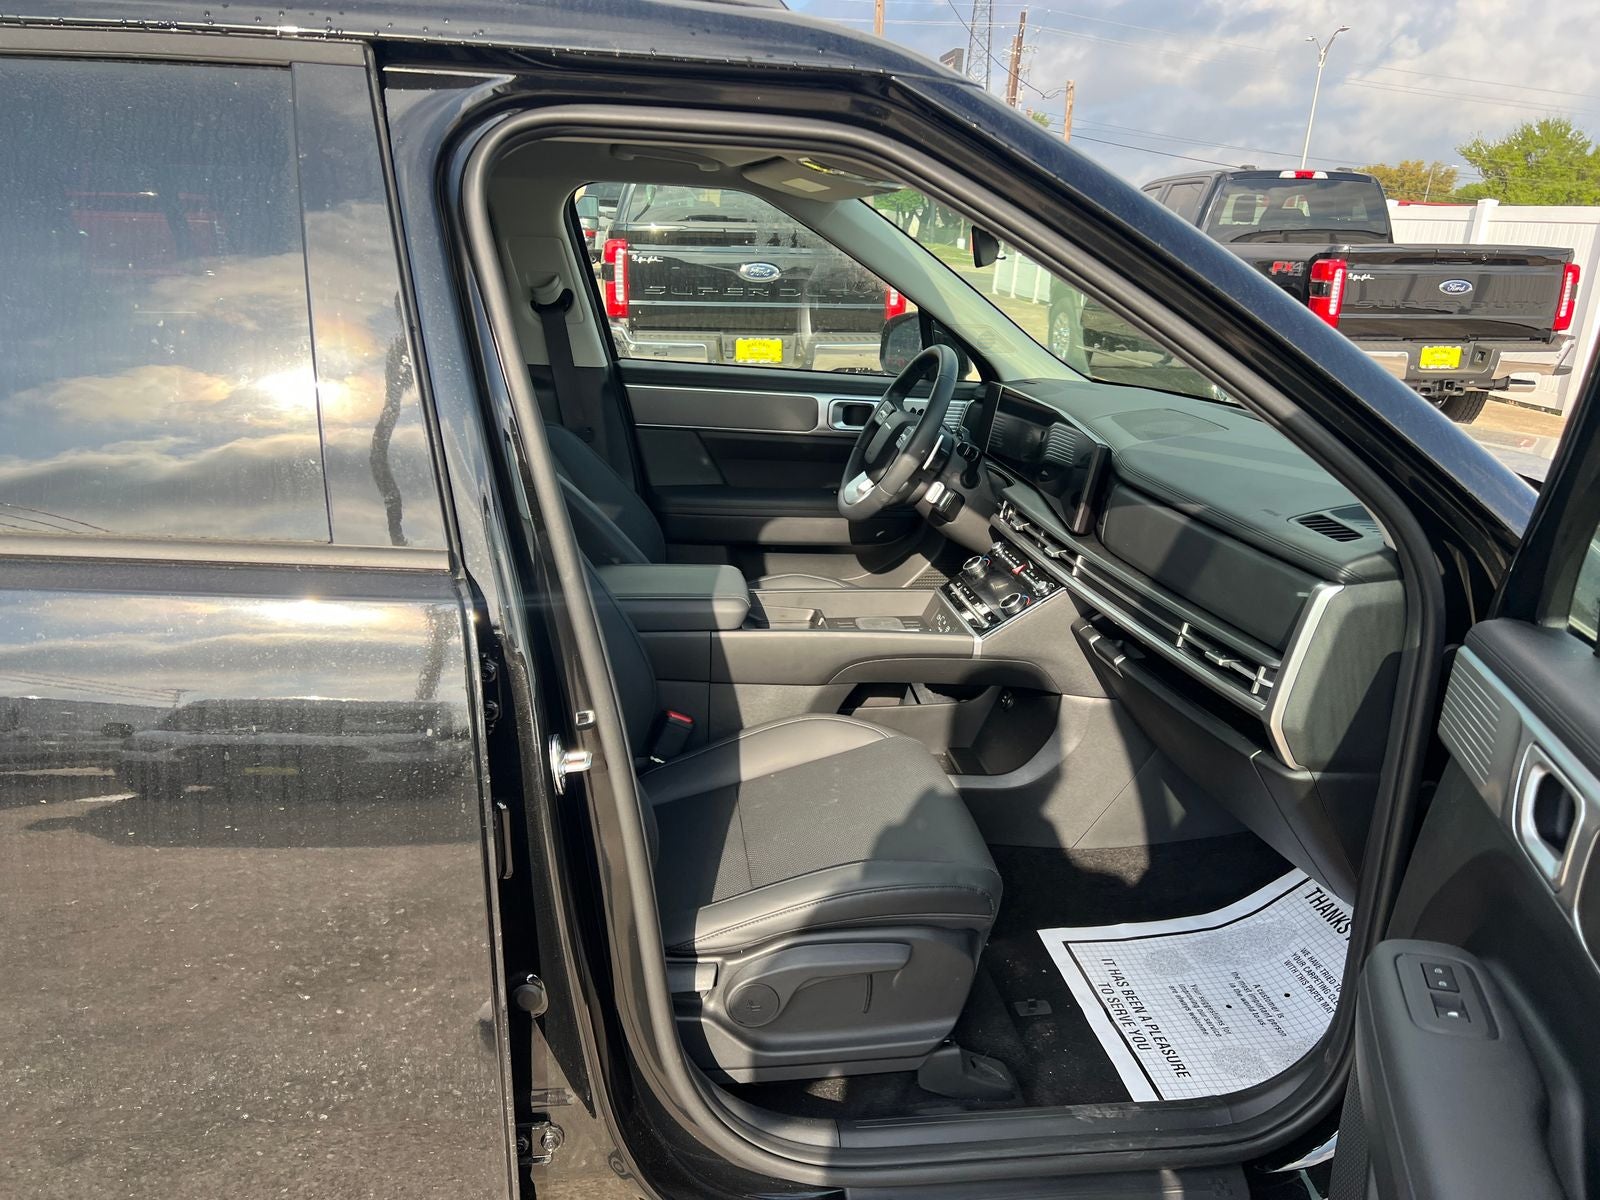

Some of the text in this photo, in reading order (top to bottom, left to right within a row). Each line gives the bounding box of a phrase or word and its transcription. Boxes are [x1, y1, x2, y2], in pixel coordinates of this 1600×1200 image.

[1271, 261, 1305, 275] FX4
[645, 285, 769, 297] SUPER
[1354, 300, 1461, 309] SUPER
[1305, 887, 1352, 935] THANKS
[1101, 958, 1117, 966] IT
[1300, 947, 1342, 993] WE HAVE TRIED TO
[1108, 968, 1130, 988] HAS
[1283, 960, 1336, 1015] WITH THIS PAPER MAT
[1291, 952, 1339, 1006] YOUR CARPETING CLE
[1121, 989, 1149, 1013] BEEN
[1175, 994, 1191, 1012] always
[1190, 983, 1232, 1035] Your suggestions for
[1231, 971, 1287, 1037] the most important person
[1240, 997, 1256, 1012] world
[1256, 988, 1280, 1012] customer
[1098, 982, 1152, 1051] TO SERVE YOU
[1203, 1018, 1222, 1038] service
[1144, 1023, 1191, 1079] PLEASURE
